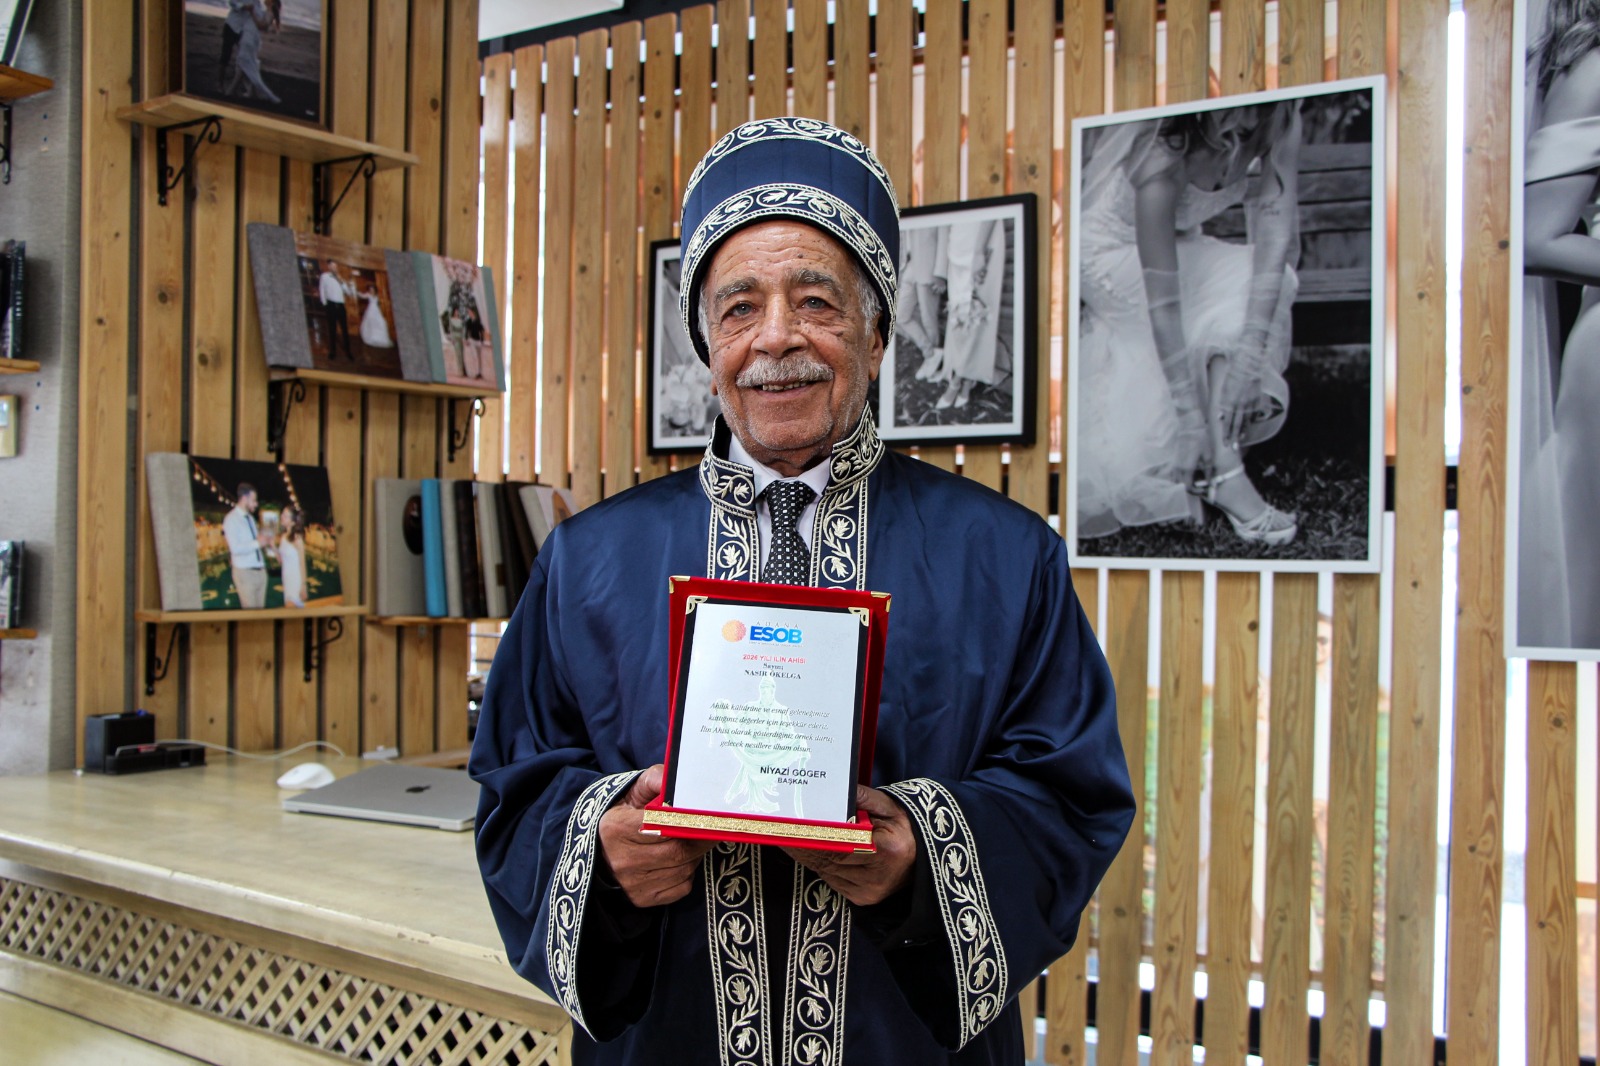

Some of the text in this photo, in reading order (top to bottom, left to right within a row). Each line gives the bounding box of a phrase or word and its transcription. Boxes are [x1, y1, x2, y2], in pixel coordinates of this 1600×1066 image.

[757, 621, 799, 629] ADANA
[750, 626, 803, 644] ESOB
[744, 669, 802, 680] NASIR ÖKELGA
[710, 702, 730, 710] Ahilik
[771, 707, 790, 716] esnaf
[739, 716, 765, 725] değerler
[766, 719, 779, 727] için
[779, 720, 807, 728] teşekkür
[731, 728, 752, 736] olarak
[752, 730, 794, 740] gösterdiğiniz
[794, 733, 813, 741] örnek
[720, 739, 744, 748] gelecek
[745, 742, 772, 750] nesillere
[773, 743, 792, 751] ilham
[760, 765, 827, 778] NİYAZİ GÖGER
[777, 777, 808, 785] BAŞKAN
